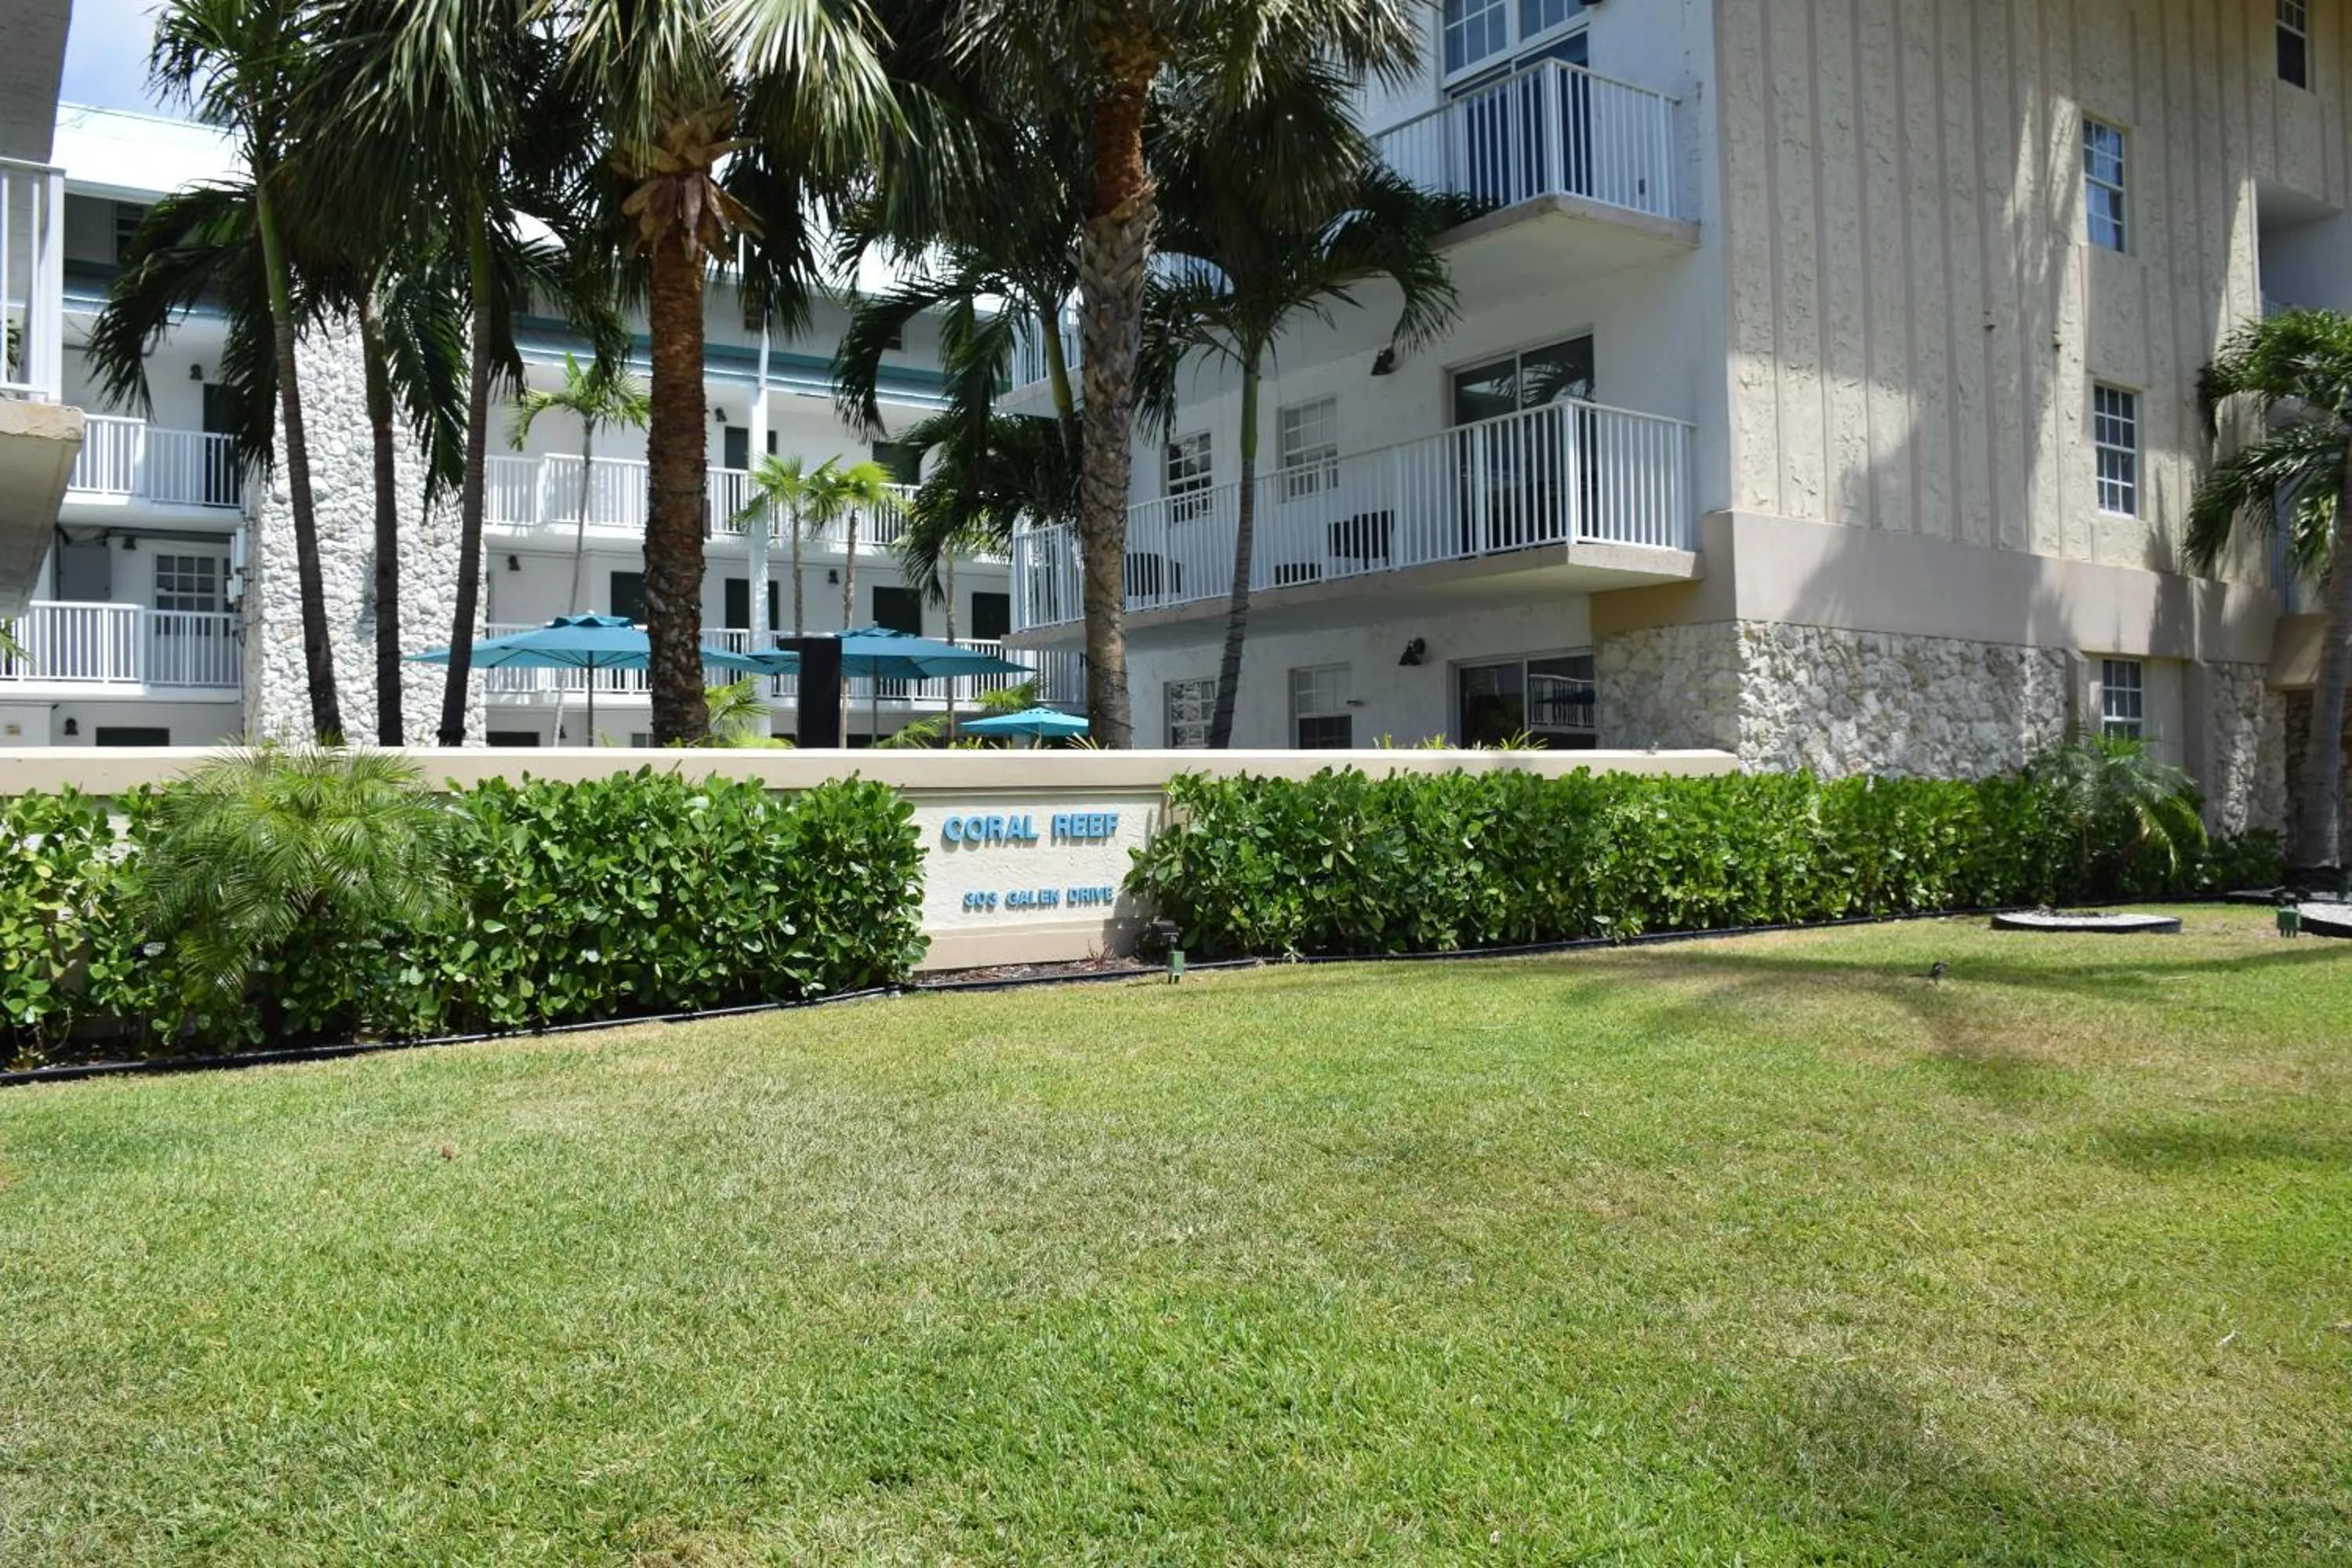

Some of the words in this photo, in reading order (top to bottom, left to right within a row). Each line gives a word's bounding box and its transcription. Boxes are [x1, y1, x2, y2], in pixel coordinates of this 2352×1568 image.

[942, 815, 1040, 843] CORAL
[1052, 812, 1120, 839] REEF
[1067, 886, 1114, 903] DRIVE
